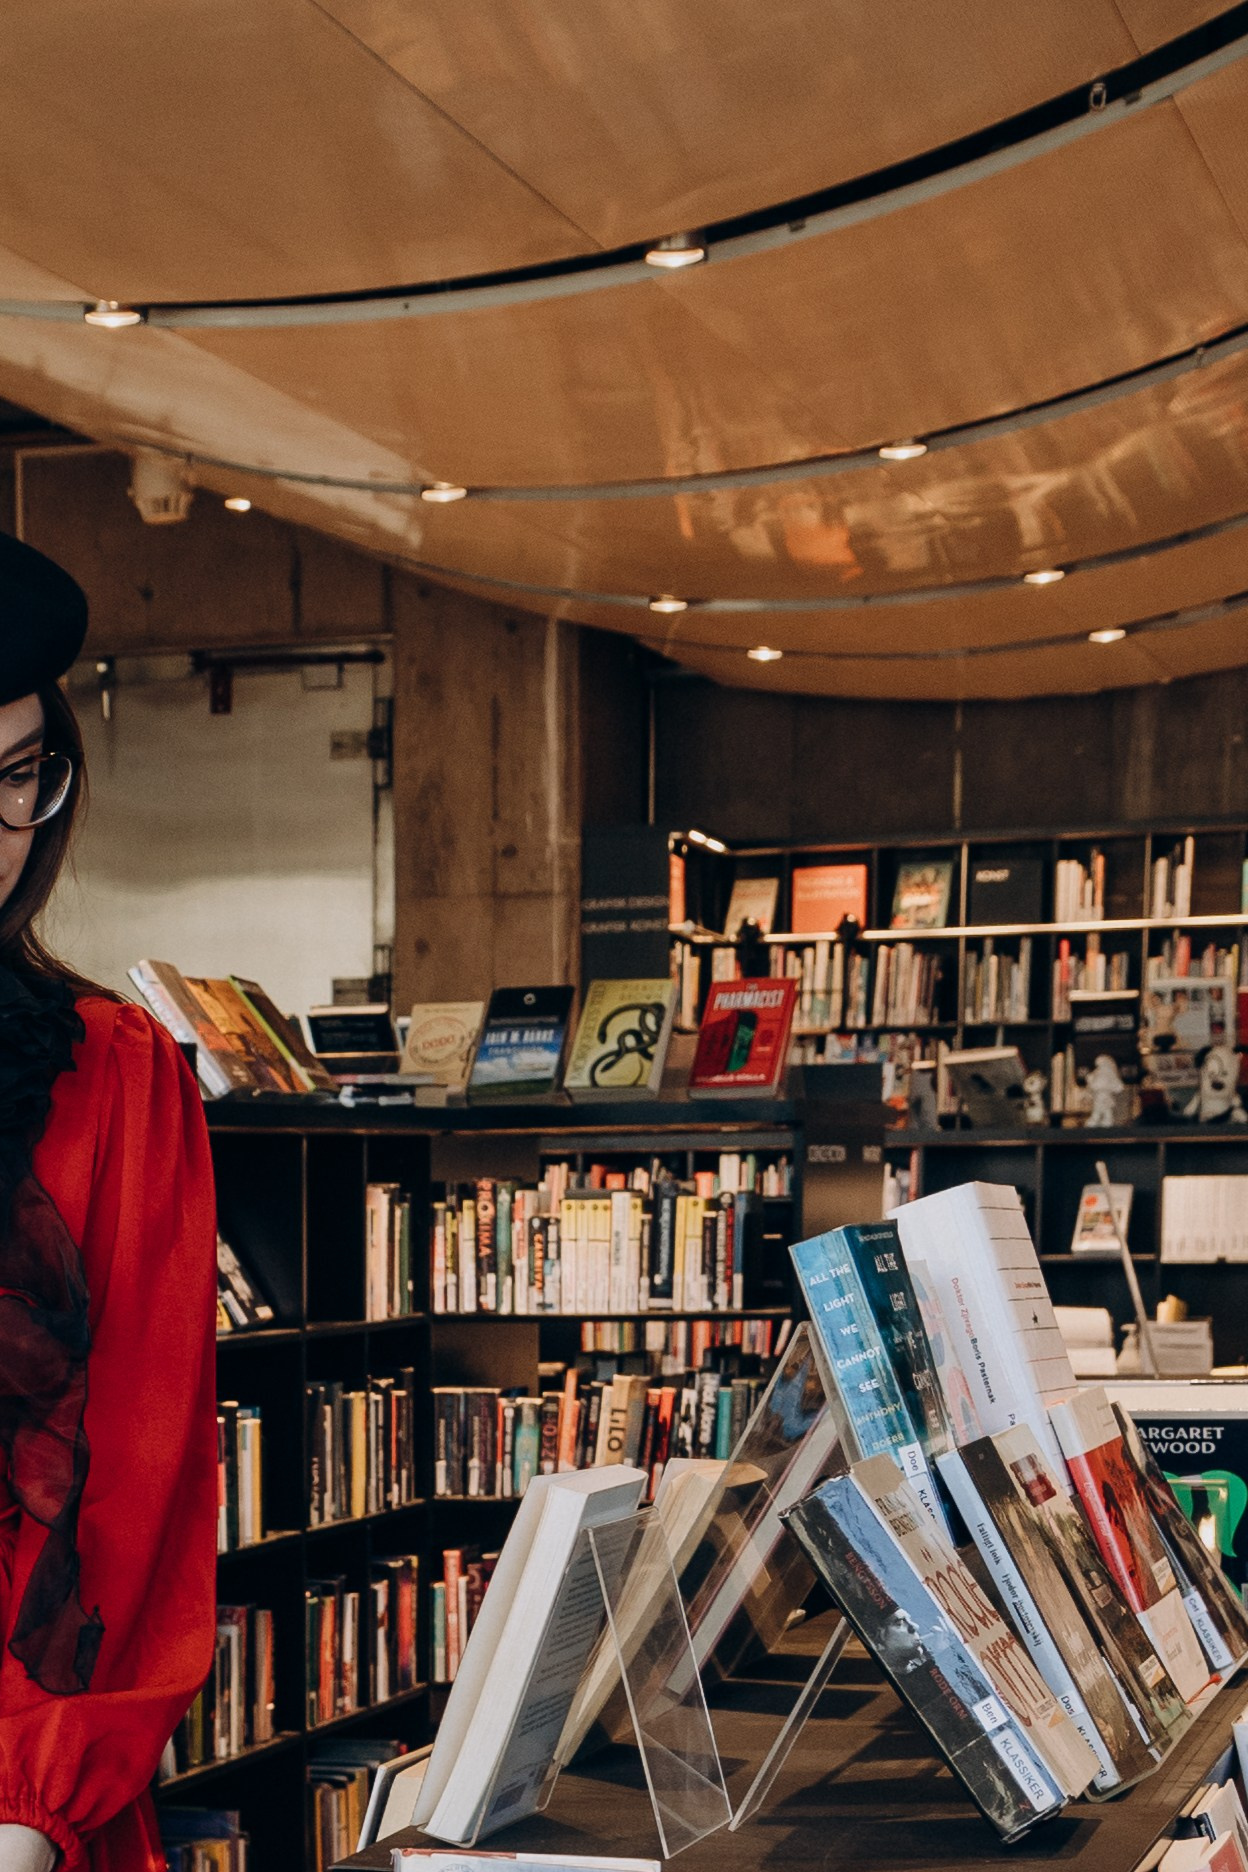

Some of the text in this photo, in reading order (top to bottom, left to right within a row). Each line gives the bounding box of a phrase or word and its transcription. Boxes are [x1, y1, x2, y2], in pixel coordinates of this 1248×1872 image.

[809, 1263, 851, 1286] ALL THE
[823, 1292, 855, 1312] LIGHT
[839, 1323, 859, 1336] WE
[951, 1277, 965, 1308] Doktor
[970, 1337, 982, 1361] Boris
[978, 1361, 996, 1405] Pasternak
[836, 1345, 882, 1370] CANNOT
[858, 1378, 880, 1394] SEE
[856, 1402, 902, 1426] ANTHONY
[1137, 1427, 1225, 1440] ARGARET
[1148, 1441, 1217, 1455] WOOD
[906, 1450, 919, 1472] Doe
[1197, 1617, 1223, 1662] KLASSIKER
[981, 1701, 1000, 1726] Ben
[1059, 1694, 1076, 1716] Dos
[999, 1736, 1046, 1801] KLASSIKER
